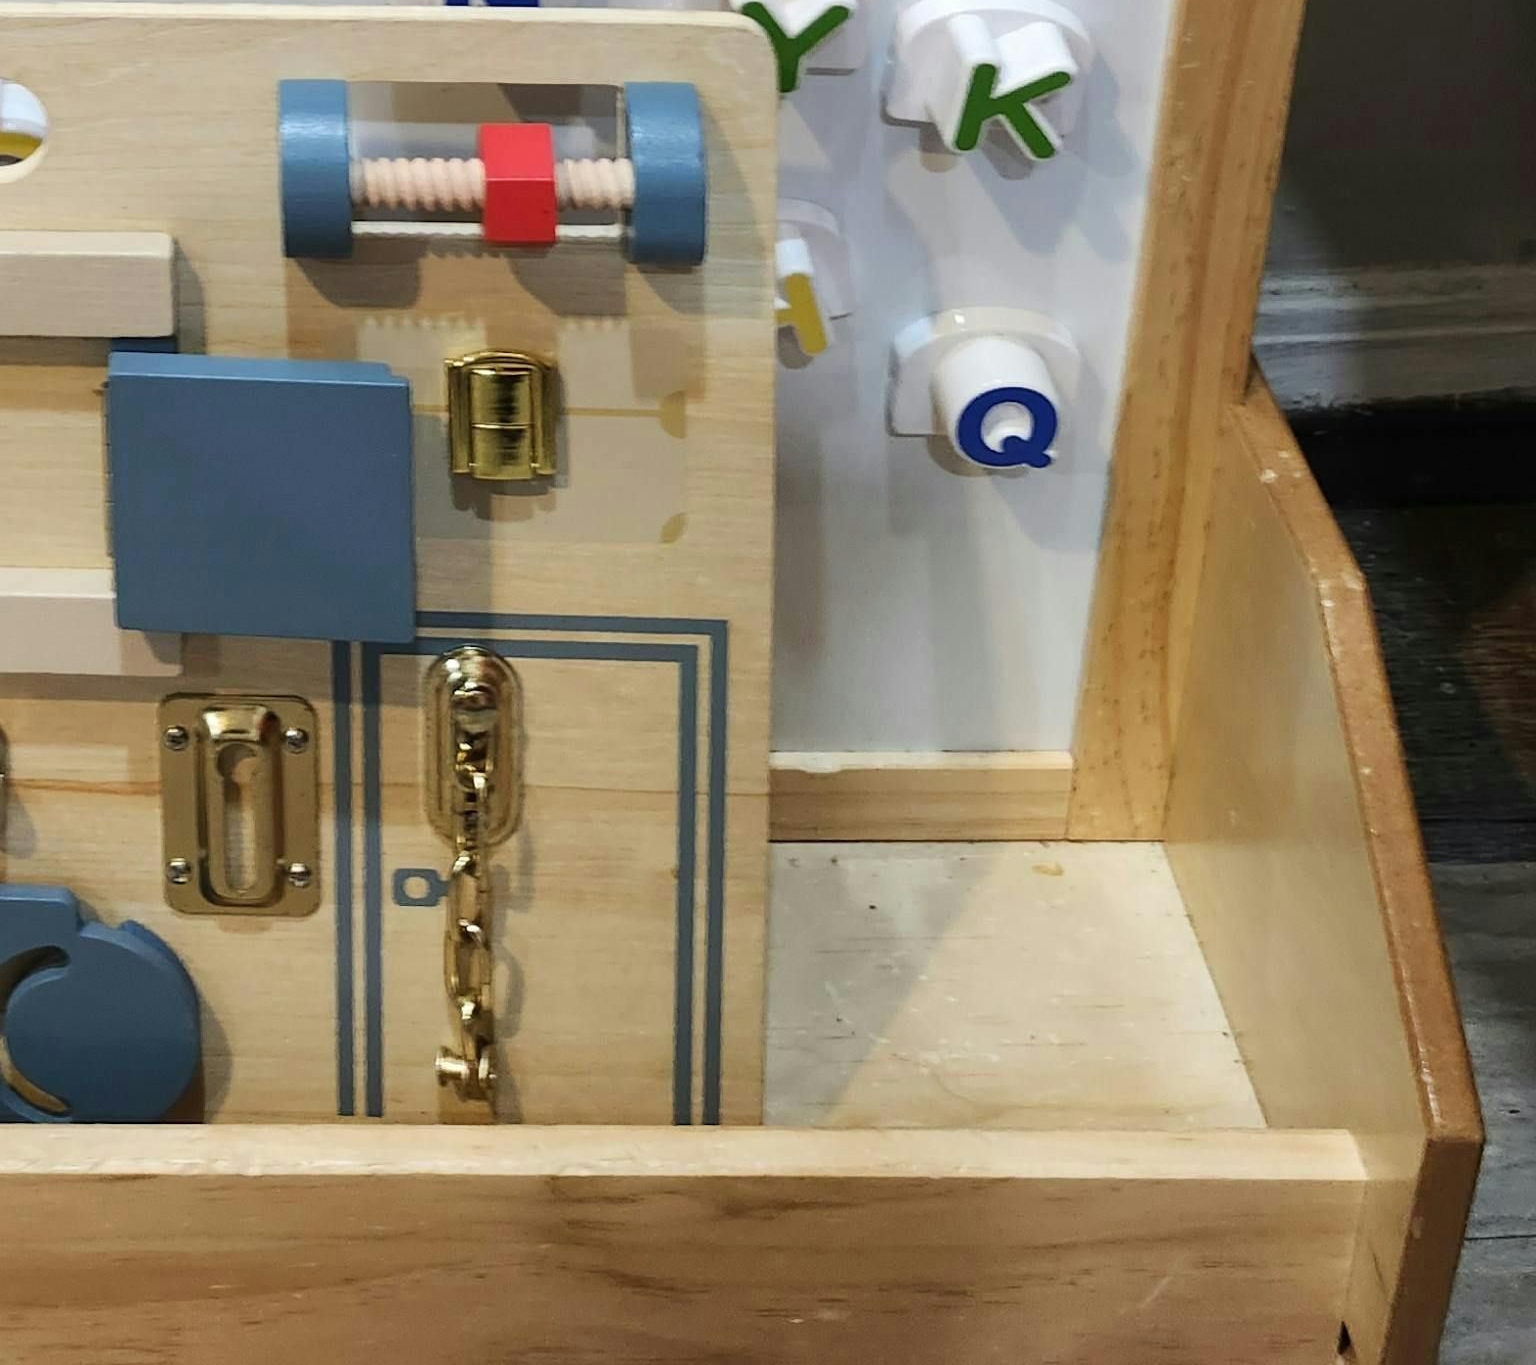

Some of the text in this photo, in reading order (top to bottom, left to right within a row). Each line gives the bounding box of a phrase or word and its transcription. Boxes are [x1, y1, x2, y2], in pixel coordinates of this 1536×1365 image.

[741, 1, 851, 94] Y
[955, 64, 1072, 159] K
[957, 386, 1058, 469] Q
